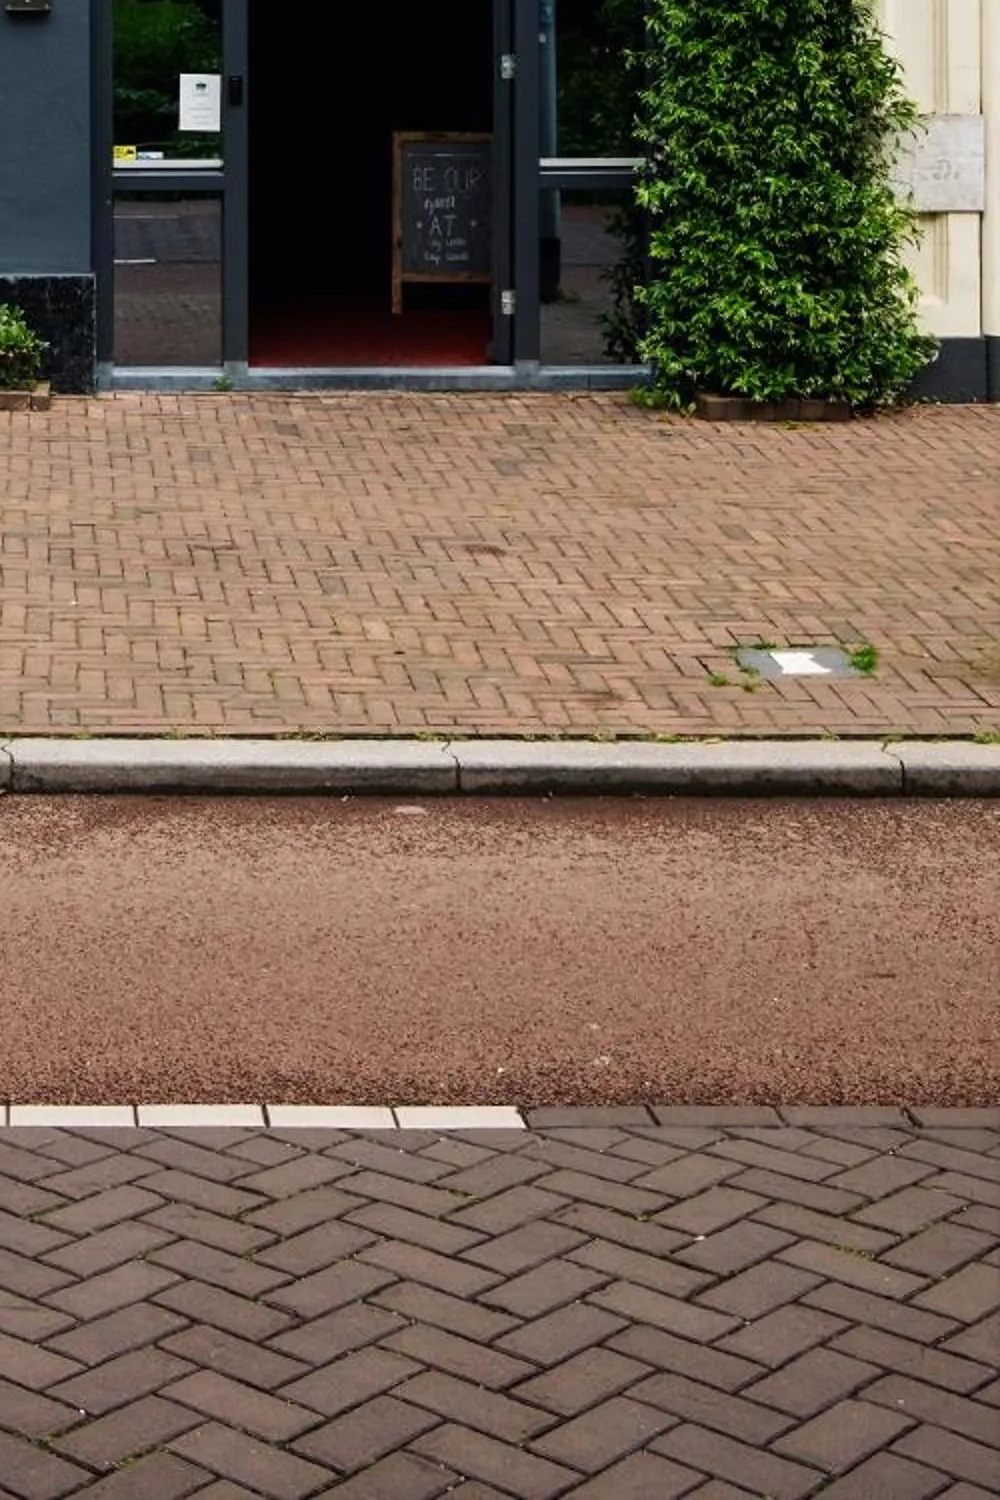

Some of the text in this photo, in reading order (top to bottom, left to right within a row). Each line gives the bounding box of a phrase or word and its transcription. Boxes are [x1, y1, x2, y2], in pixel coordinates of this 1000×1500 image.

[413, 166, 481, 193] BE OUR
[428, 215, 457, 237] AT
